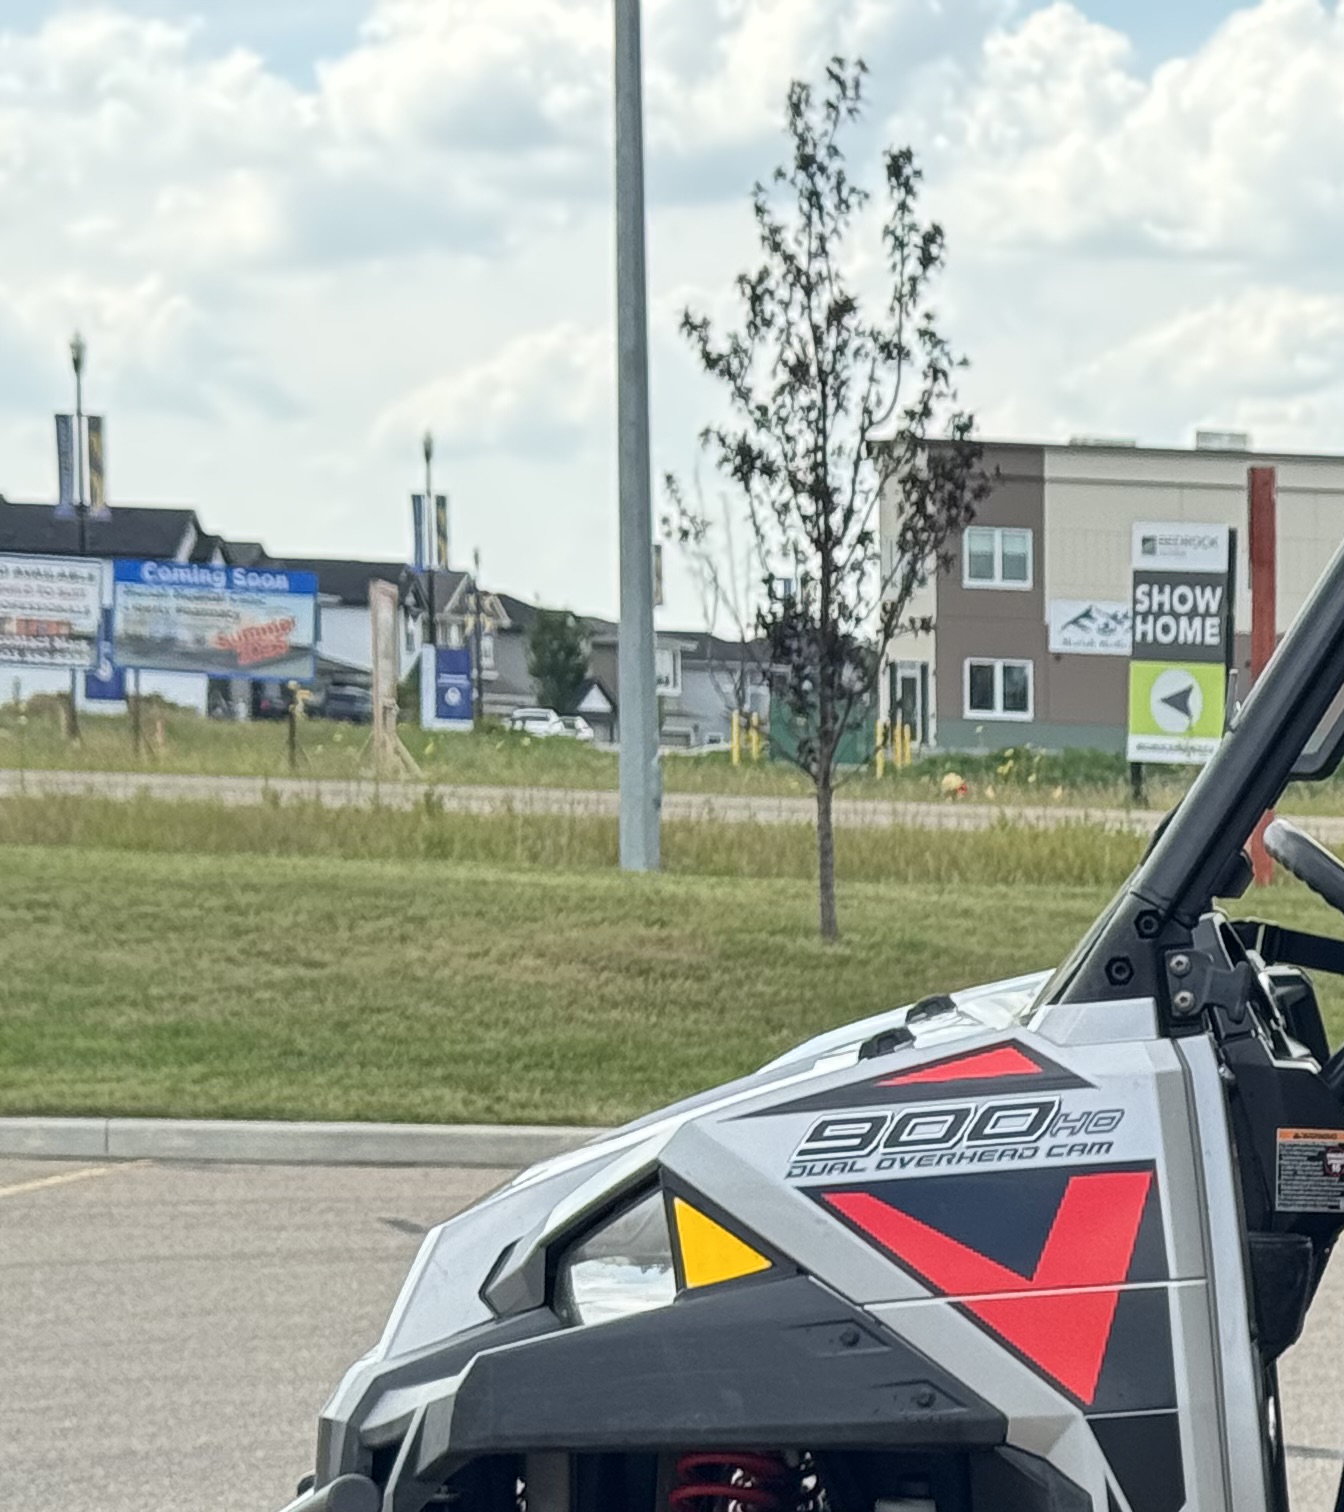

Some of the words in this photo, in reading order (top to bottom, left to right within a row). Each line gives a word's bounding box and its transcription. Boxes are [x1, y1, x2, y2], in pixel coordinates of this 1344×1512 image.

[140, 561, 226, 589] Coming
[232, 566, 289, 591] Soon
[1135, 583, 1223, 614] SHOW
[1135, 615, 1221, 645] HOME
[789, 1094, 1062, 1163] 900
[784, 1160, 867, 1180] DUAL
[873, 1145, 1040, 1172] OVERHEAD
[1044, 1140, 1115, 1157] CAM
